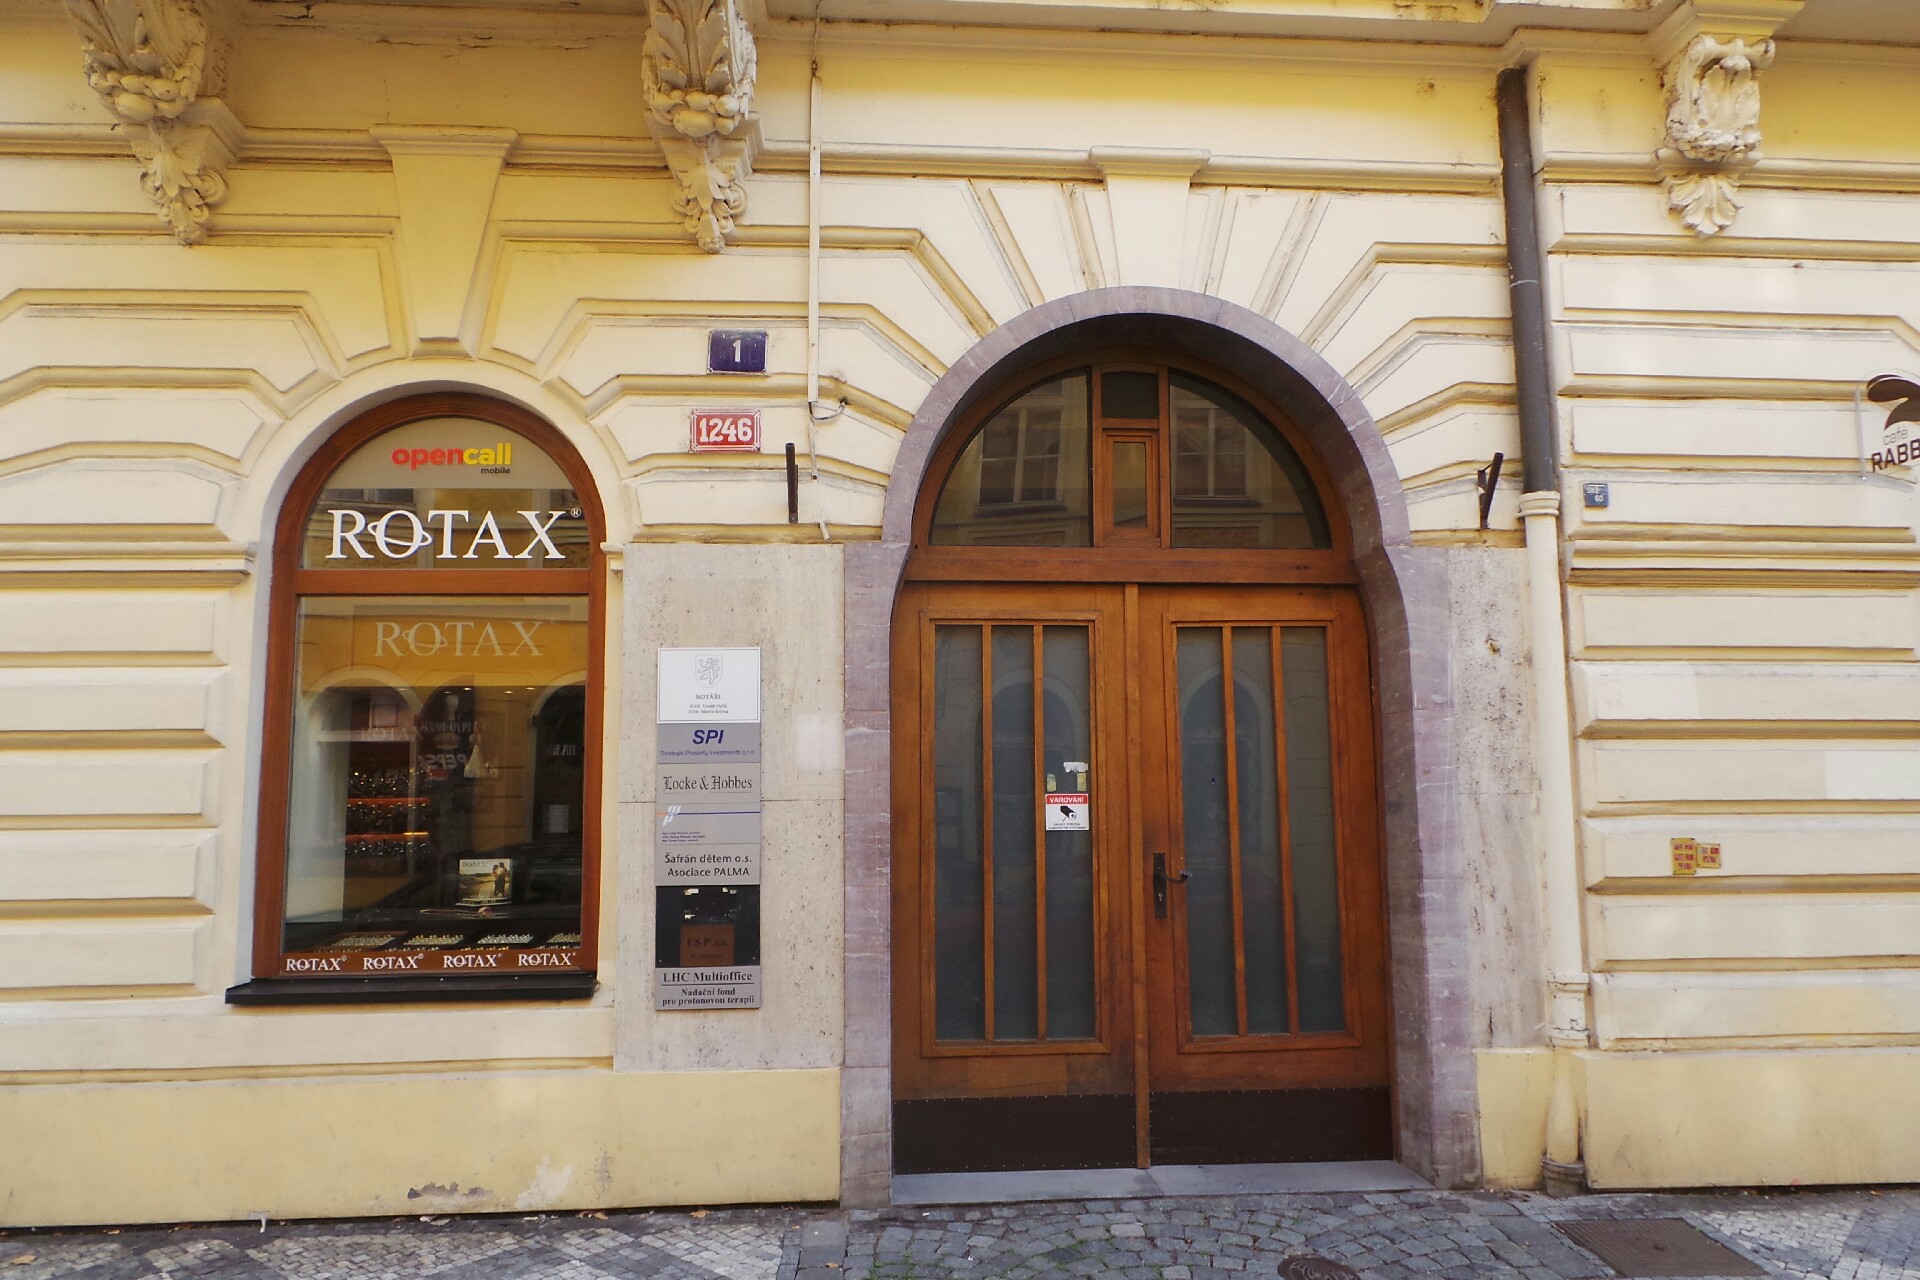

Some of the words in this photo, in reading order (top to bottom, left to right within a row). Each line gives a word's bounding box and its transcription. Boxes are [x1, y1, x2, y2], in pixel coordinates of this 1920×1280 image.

[732, 339, 742, 362] 1
[699, 418, 753, 443] 1246
[1882, 426, 1908, 446] café
[391, 442, 512, 470] opencall
[480, 467, 511, 475] mobile
[374, 621, 544, 657] ROTAX
[692, 729, 724, 745] SPI
[663, 775, 698, 790] Locke
[699, 775, 709, 790] &
[711, 775, 753, 790] Hobbes
[1049, 795, 1086, 804] VAROVÁNÍ
[665, 852, 697, 864] Šafrán
[699, 854, 732, 863] dětem
[734, 855, 752, 863] o.s.
[667, 867, 711, 877] Asociace
[713, 867, 750, 877] PALMA
[443, 954, 498, 968] ROTAX
[518, 952, 572, 966] ROTAX
[663, 972, 690, 982] LHC
[693, 970, 753, 982] Multioffice
[681, 987, 716, 996] Nadační
[717, 987, 736, 996] fond
[662, 998, 676, 1007] pro
[678, 997, 726, 1007] protonovou
[727, 995, 755, 1006] terapii
